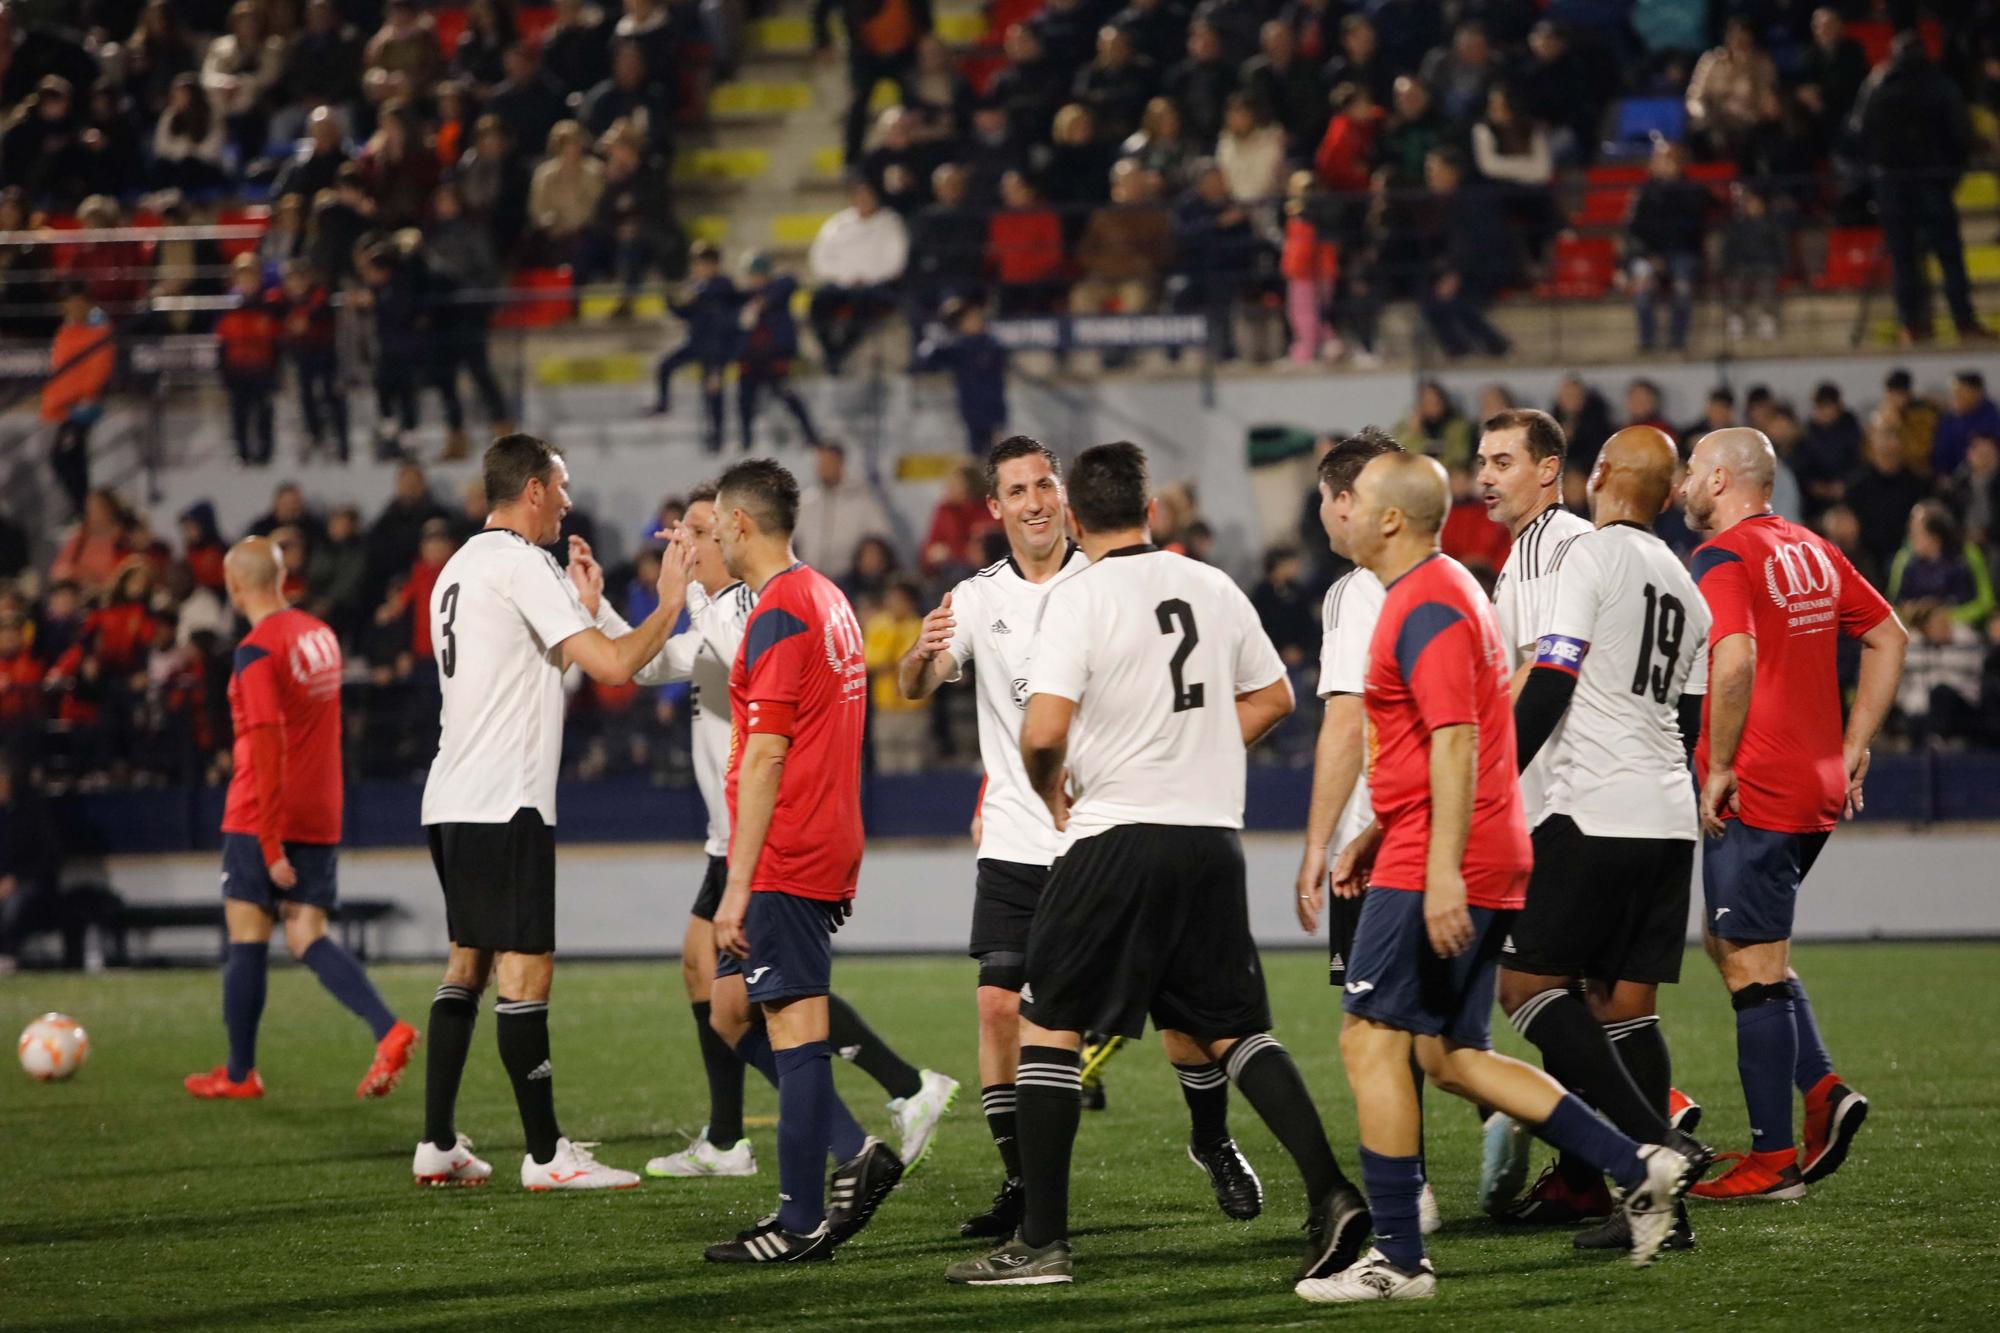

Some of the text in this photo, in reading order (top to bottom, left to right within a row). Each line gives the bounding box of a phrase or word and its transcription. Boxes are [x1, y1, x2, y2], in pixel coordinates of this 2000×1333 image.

[1774, 541, 1829, 596] 100
[440, 582, 460, 678] 3
[1155, 598, 1204, 712] 2
[1631, 582, 1686, 704] 19
